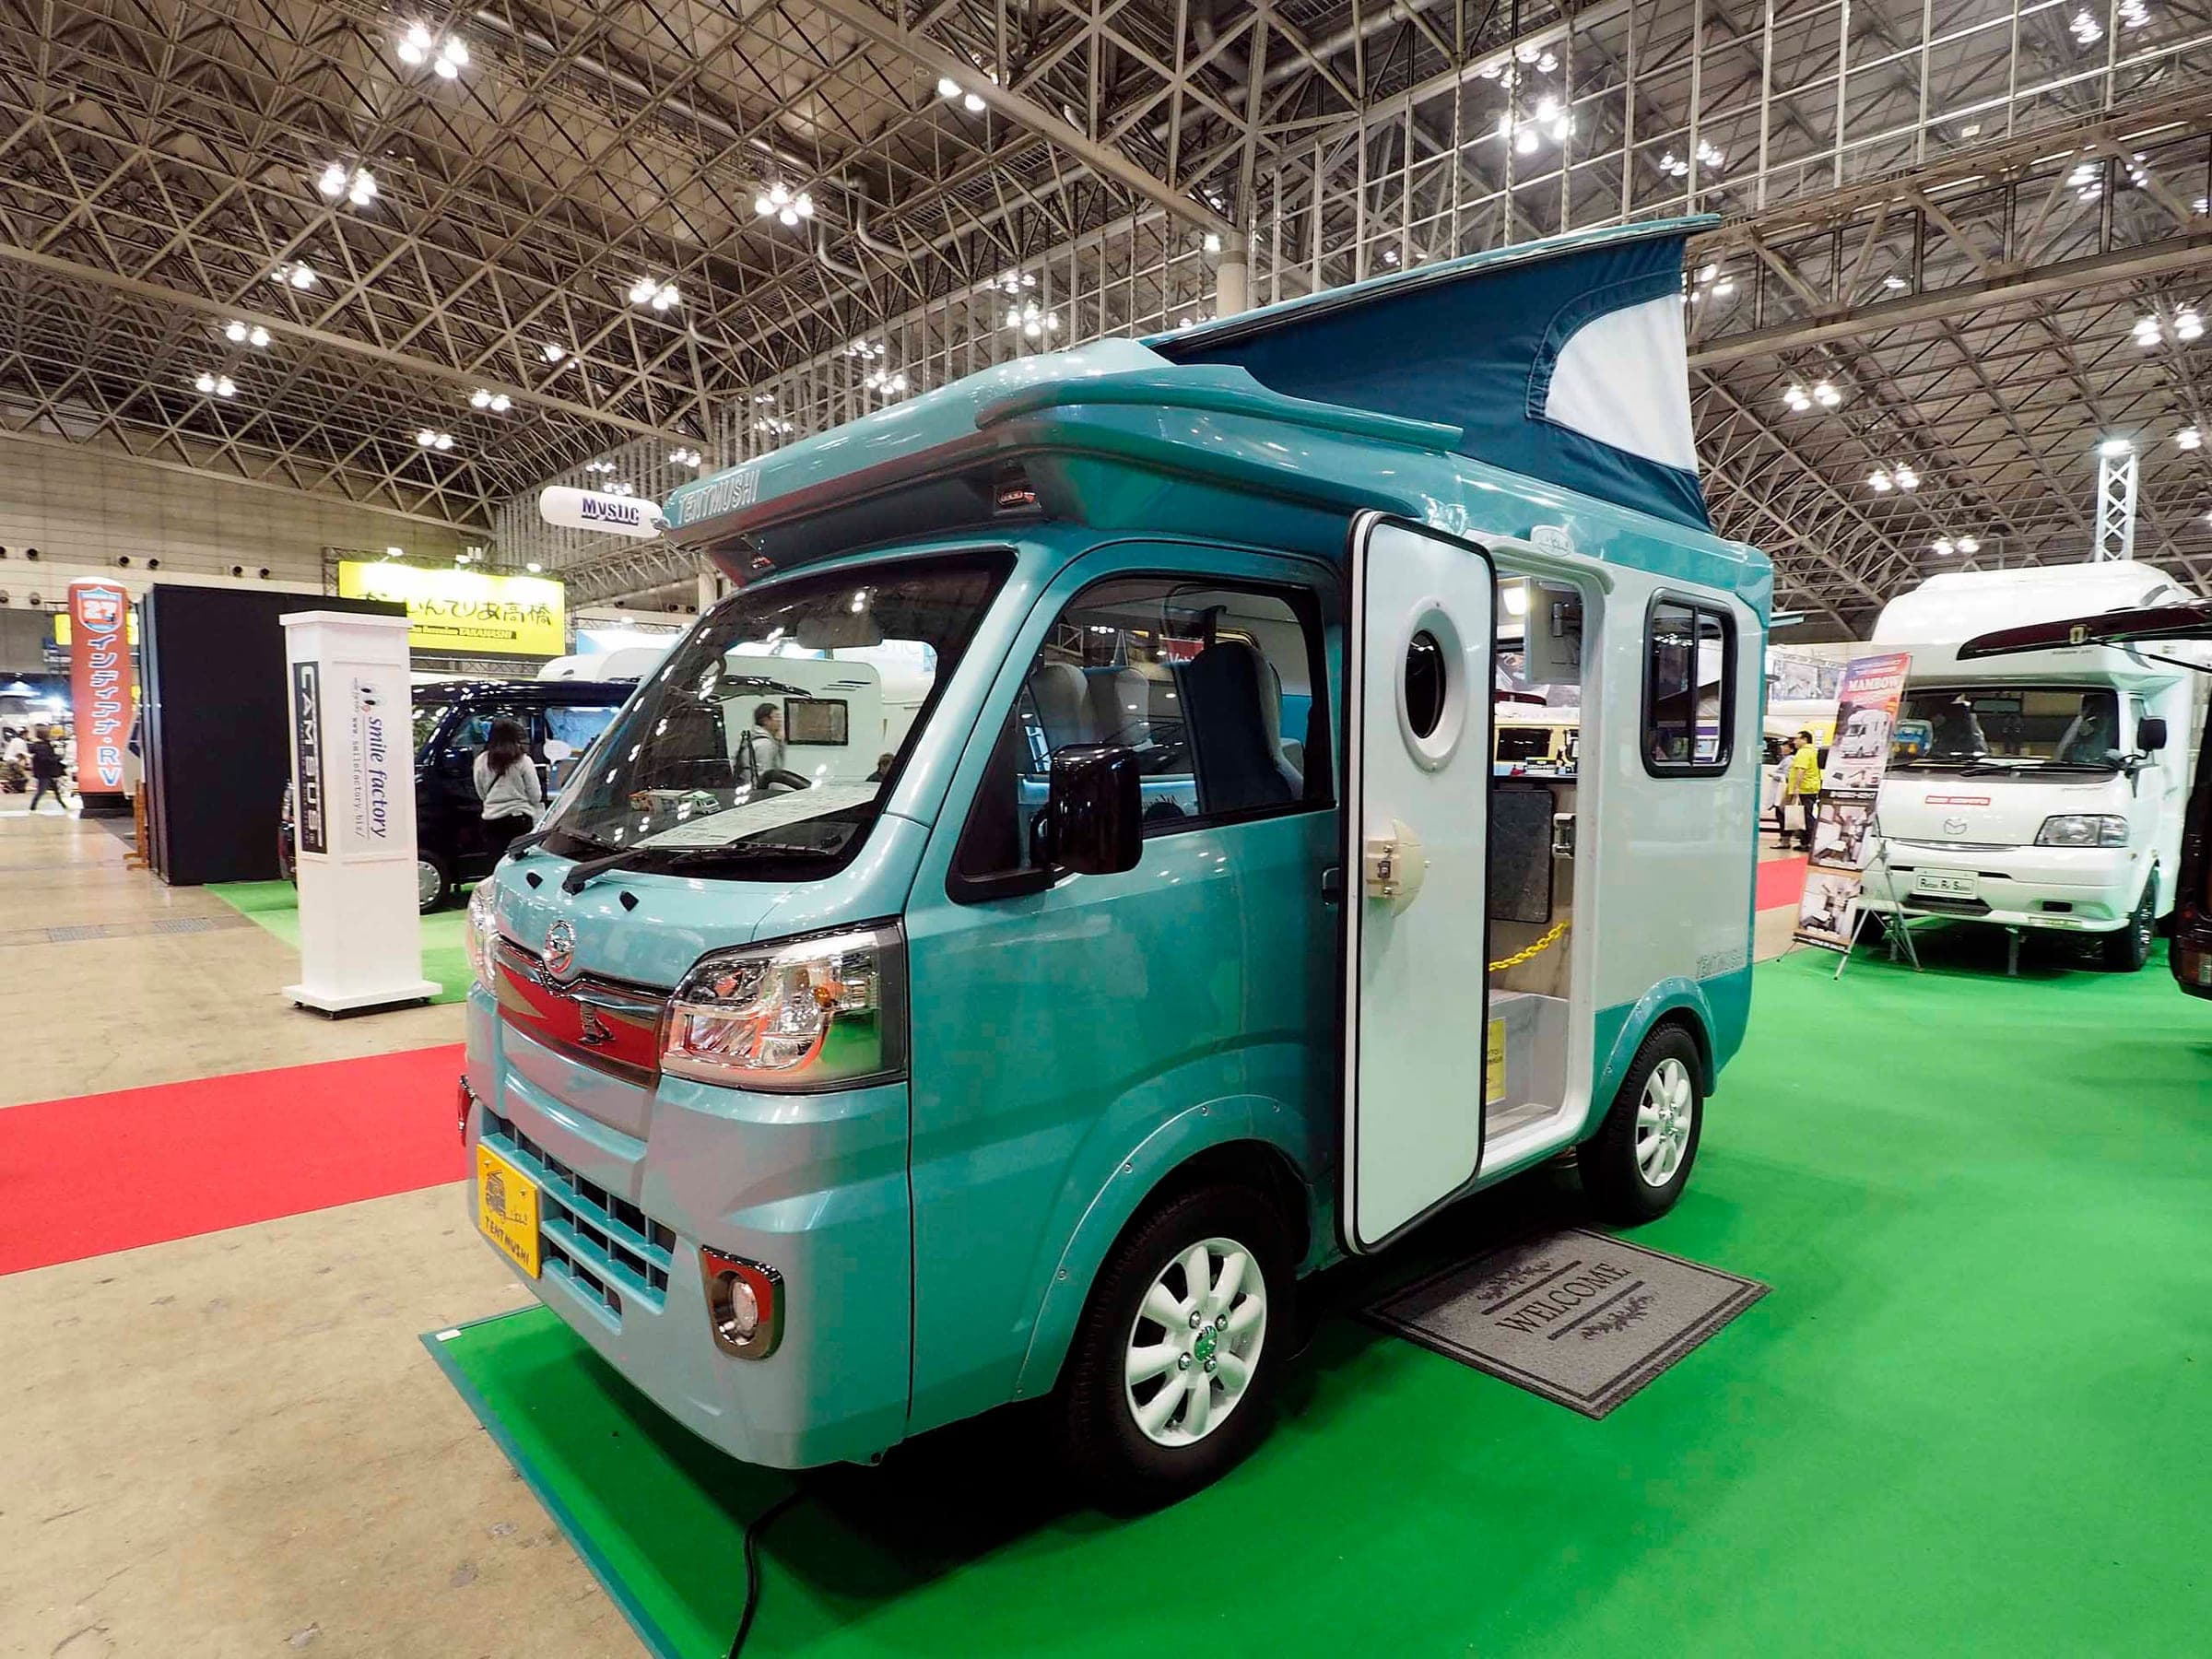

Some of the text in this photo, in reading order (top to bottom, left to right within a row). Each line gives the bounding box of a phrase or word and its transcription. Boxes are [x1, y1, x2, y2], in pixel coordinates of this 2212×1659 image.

[582, 498, 640, 523] Mystic
[677, 469, 760, 525] TENTMUSHI
[369, 717, 388, 839] smile factory
[1494, 1262, 1632, 1335] WELCOME
